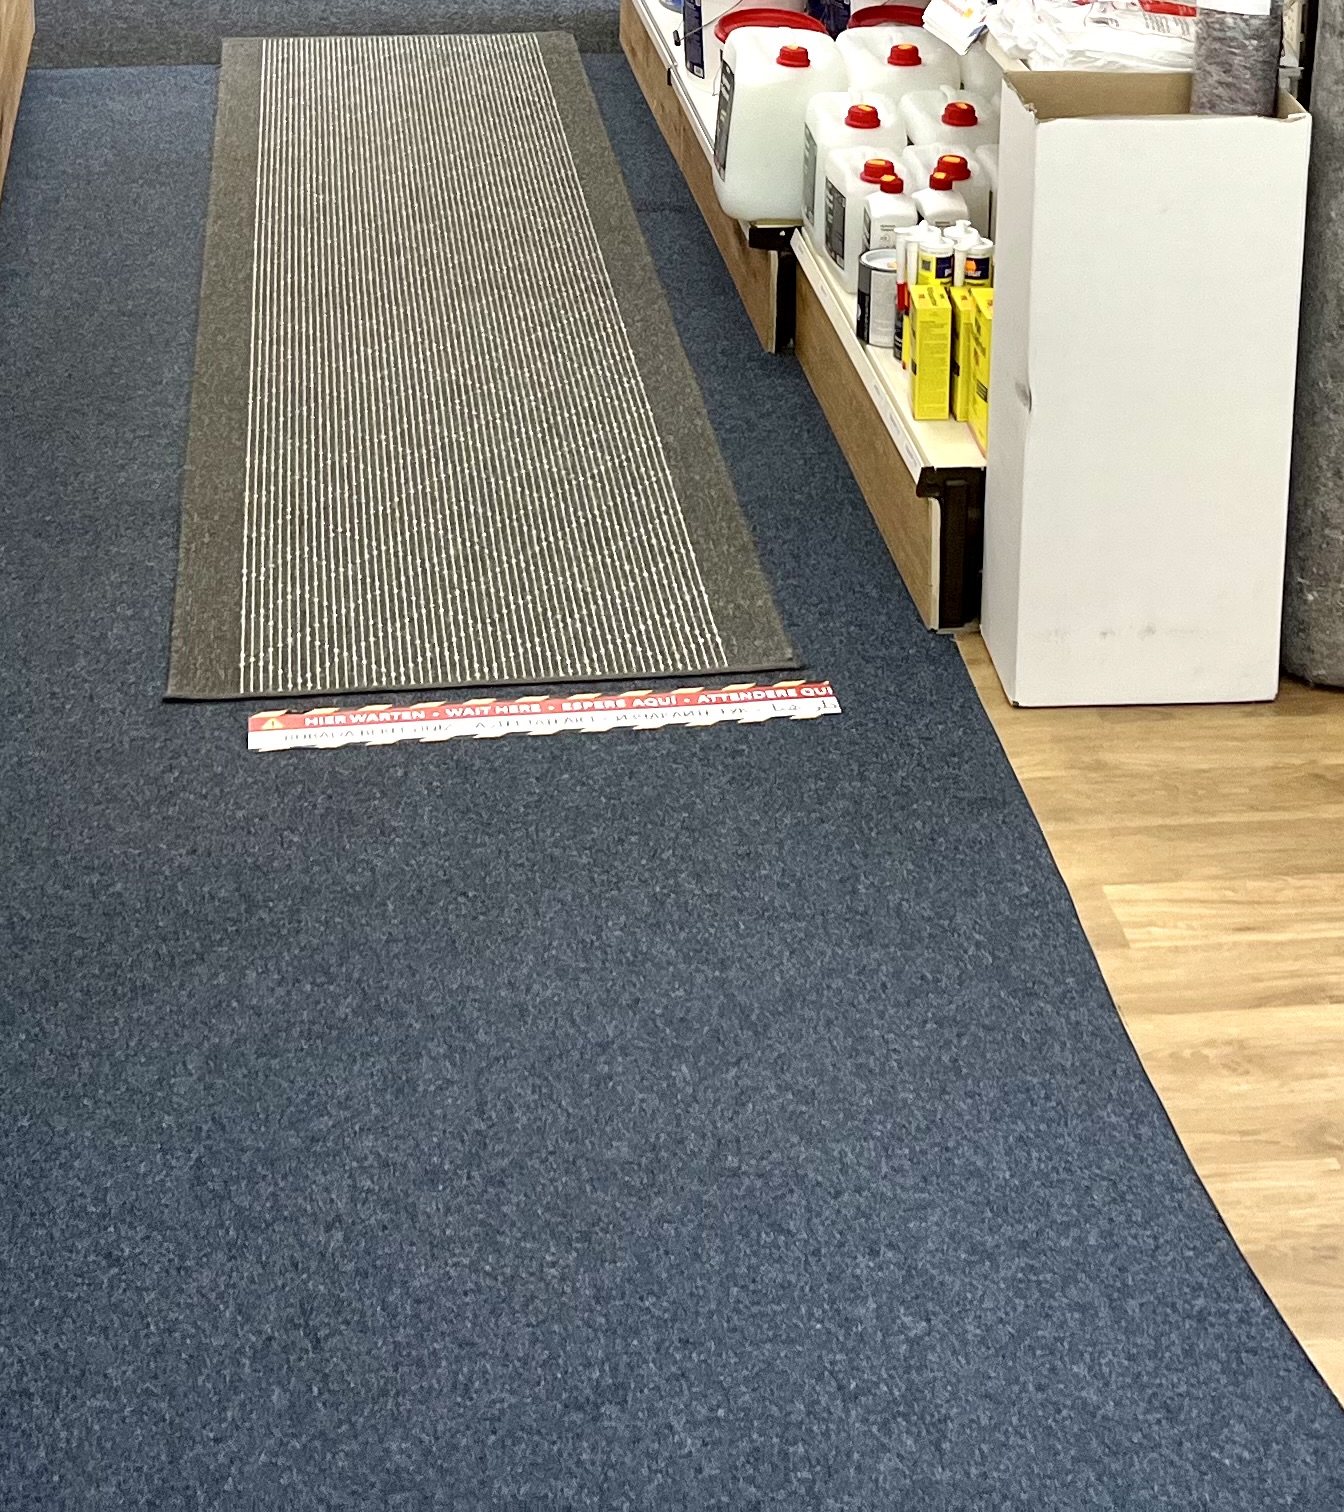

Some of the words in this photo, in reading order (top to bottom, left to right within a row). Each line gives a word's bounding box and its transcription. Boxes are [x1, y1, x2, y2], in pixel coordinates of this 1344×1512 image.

[304, 717, 348, 728] HIER
[349, 710, 426, 726] WARTEN
[445, 705, 492, 717] WAIT
[495, 703, 541, 714] HERE
[561, 698, 626, 712] ESPERE
[698, 688, 798, 704] ATTENDERE
[800, 685, 834, 697] QUI
